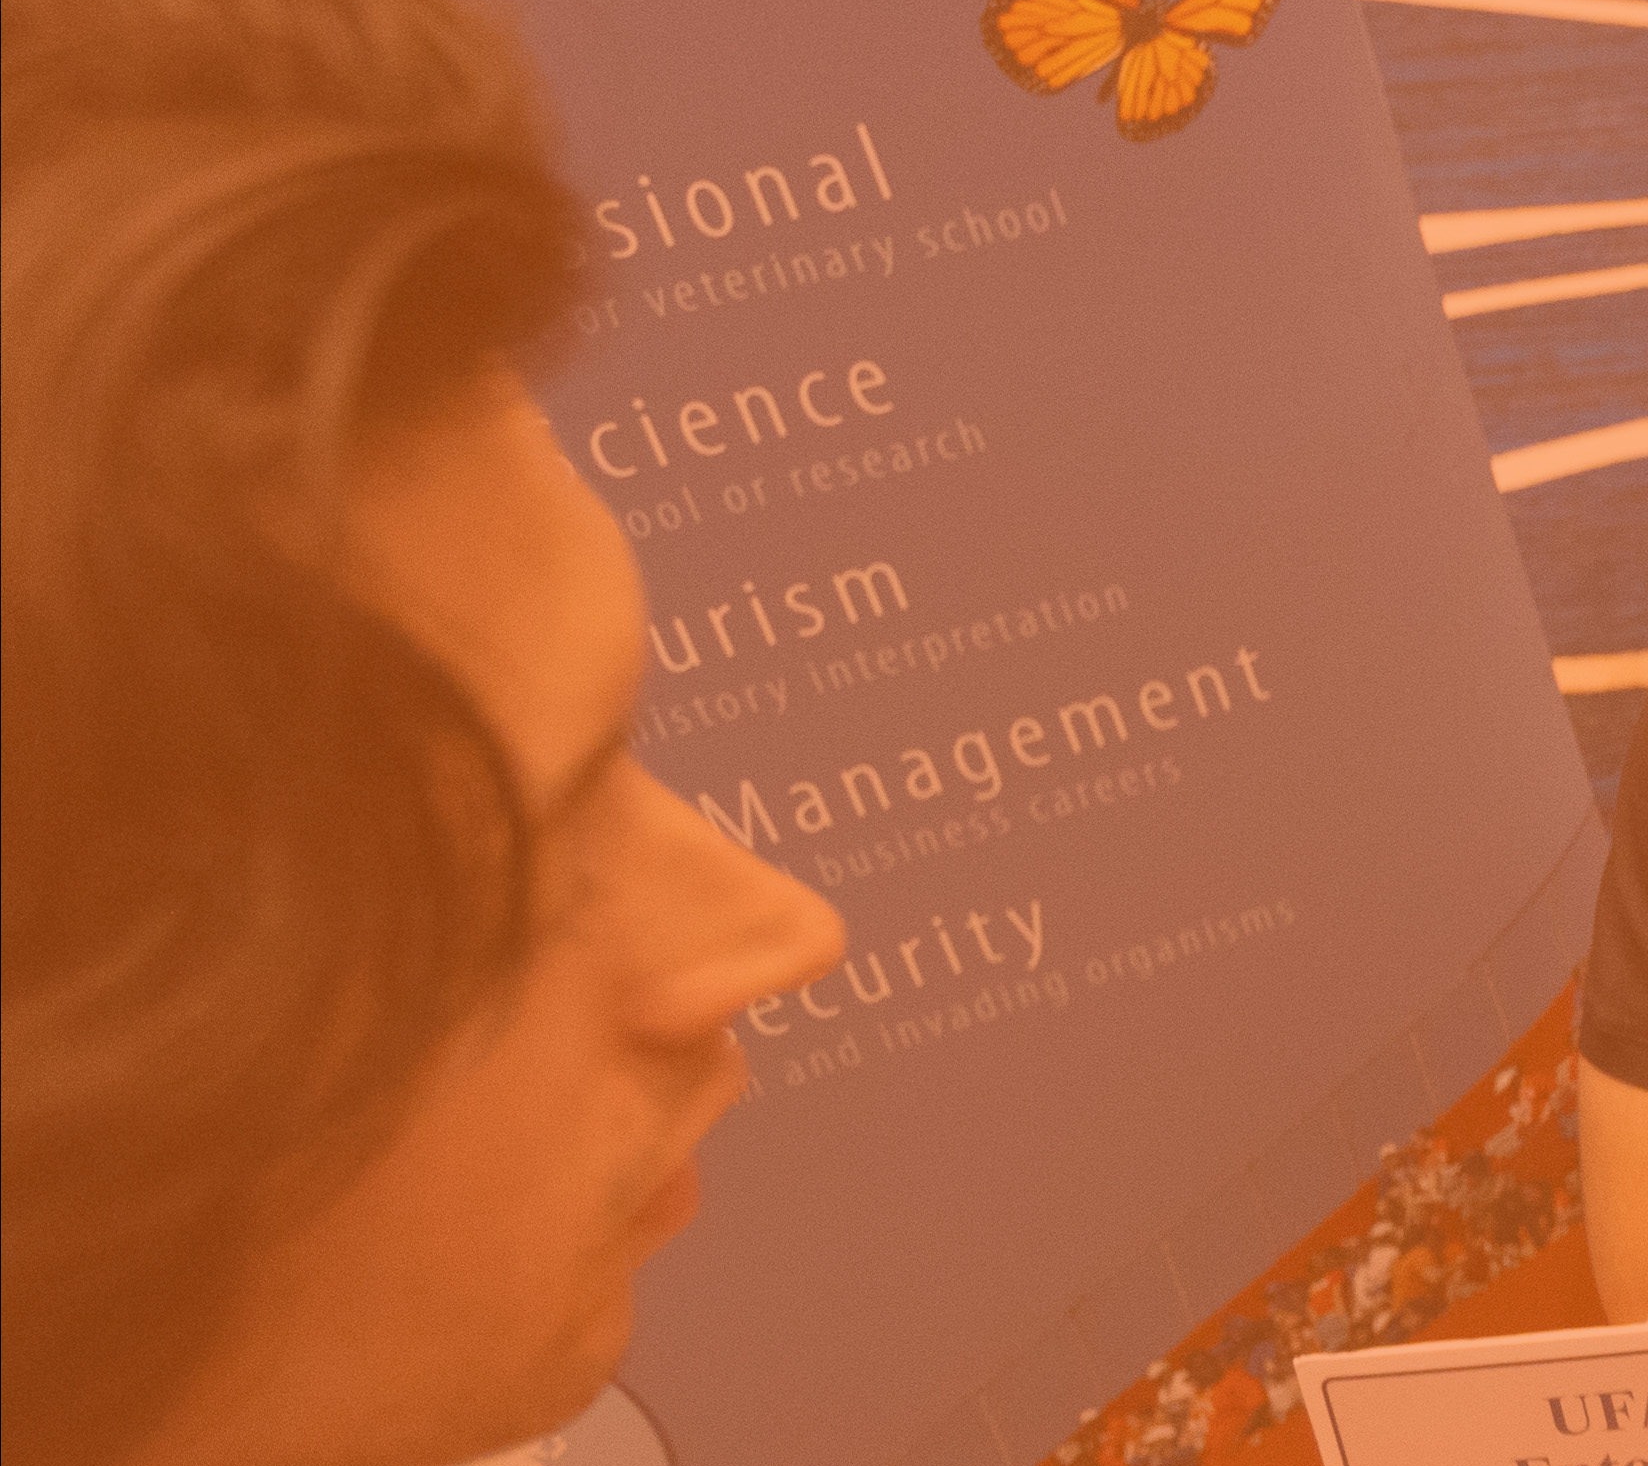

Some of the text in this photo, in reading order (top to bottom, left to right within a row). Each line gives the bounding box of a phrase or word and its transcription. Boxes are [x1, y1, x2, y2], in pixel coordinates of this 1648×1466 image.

[641, 233, 898, 321] veterinary
[914, 186, 1072, 261] school
[588, 357, 896, 481] cience
[721, 476, 769, 518] or
[789, 416, 990, 499] research
[650, 559, 911, 675] urism
[807, 582, 1131, 698] interpretation
[697, 644, 1273, 853] Management
[813, 753, 1184, 890] business careers
[721, 898, 1047, 1048] ecurity
[783, 1034, 865, 1088] and
[877, 967, 1072, 1056] invading
[1082, 895, 1299, 987] organisms
